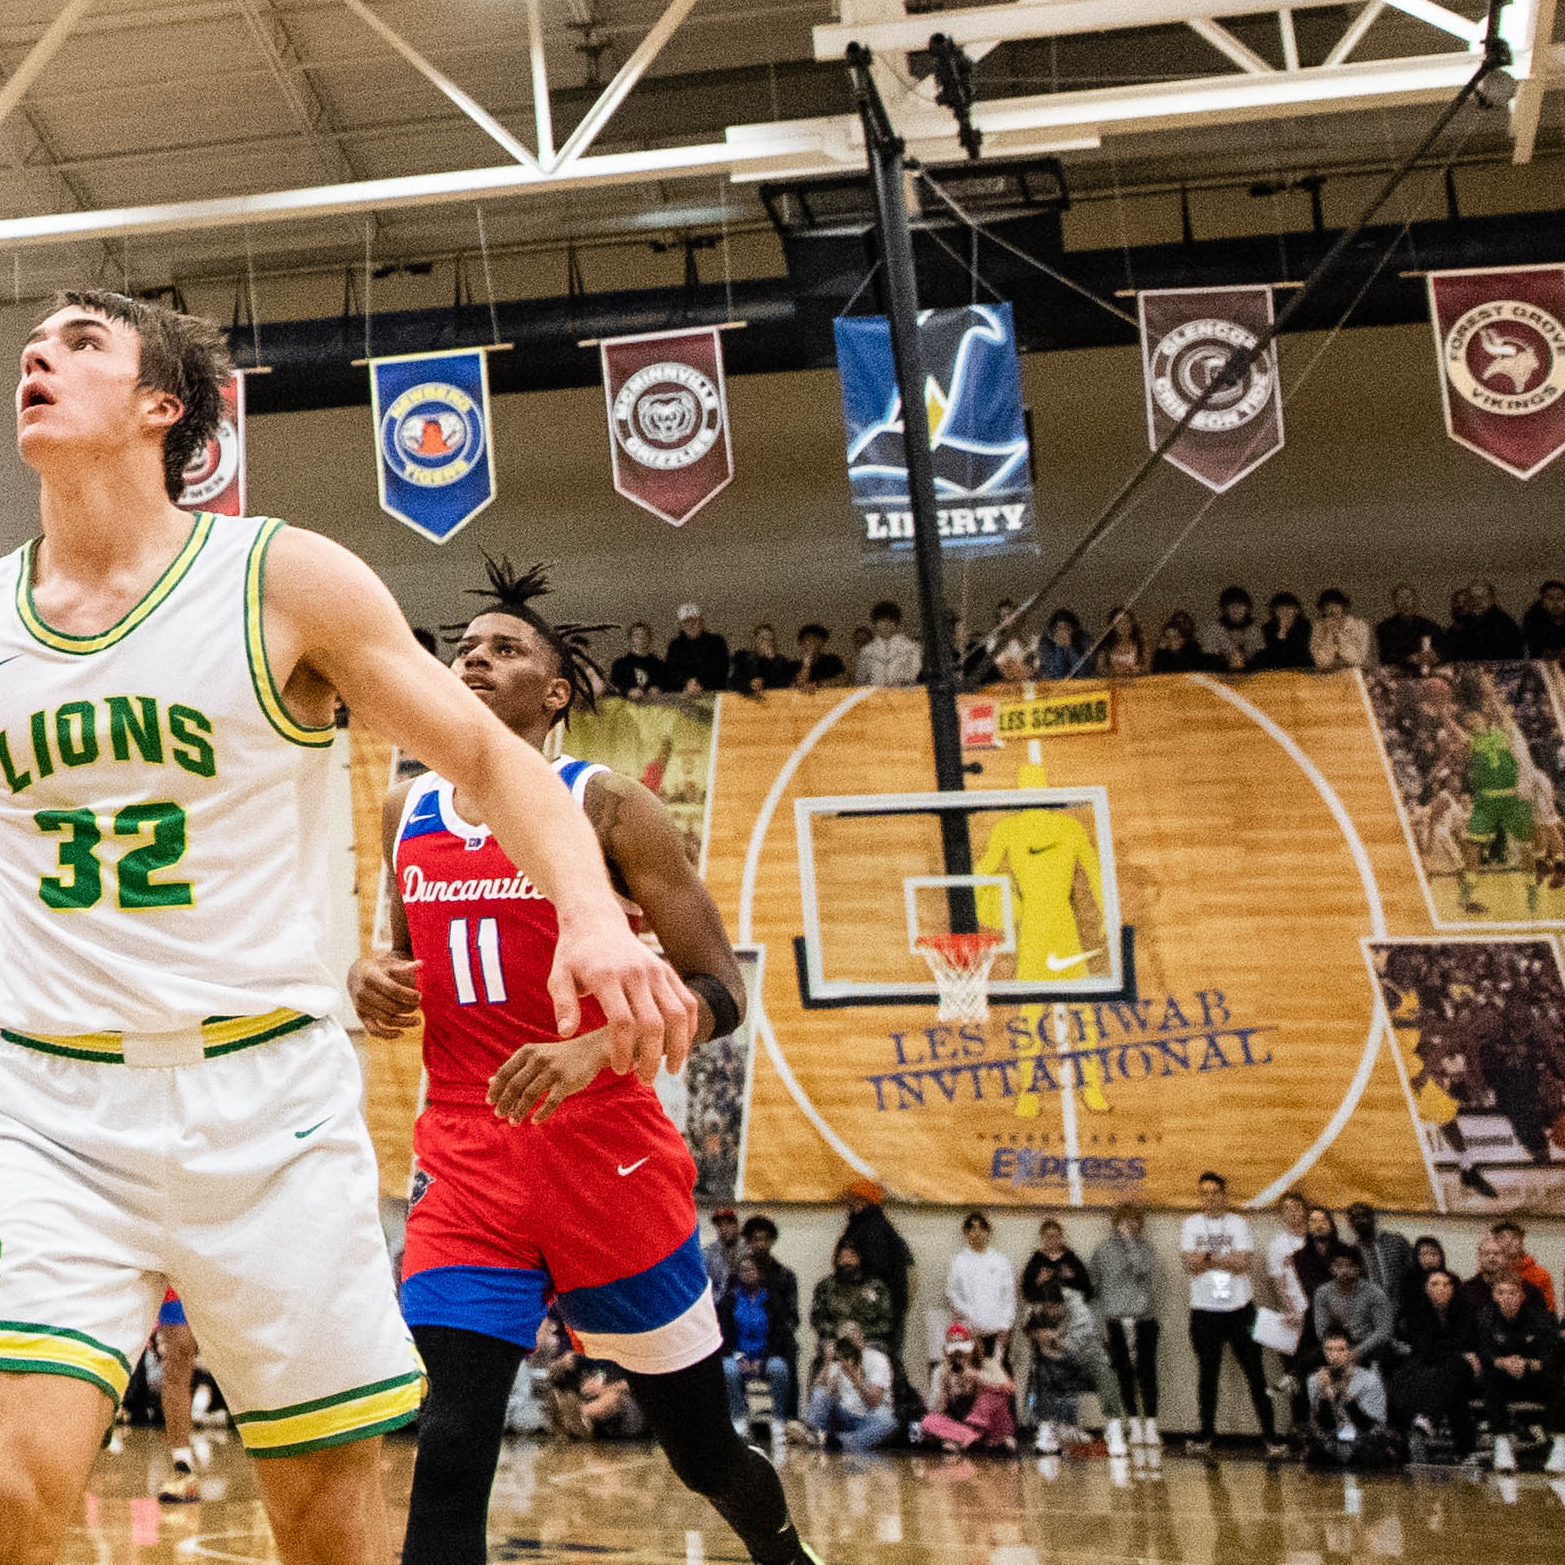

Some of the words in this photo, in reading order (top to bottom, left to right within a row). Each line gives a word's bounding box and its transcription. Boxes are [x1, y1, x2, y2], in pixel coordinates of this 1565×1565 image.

[1472, 385, 1559, 410] VIKINGS
[404, 459, 468, 486] TIGERS
[864, 503, 1026, 541] LIERTY
[33, 800, 197, 911] 32
[447, 917, 508, 1006] 11
[888, 1024, 988, 1066] LES
[1005, 988, 1232, 1051] SCHWAB
[867, 1027, 1274, 1111] INVITATIONAL
